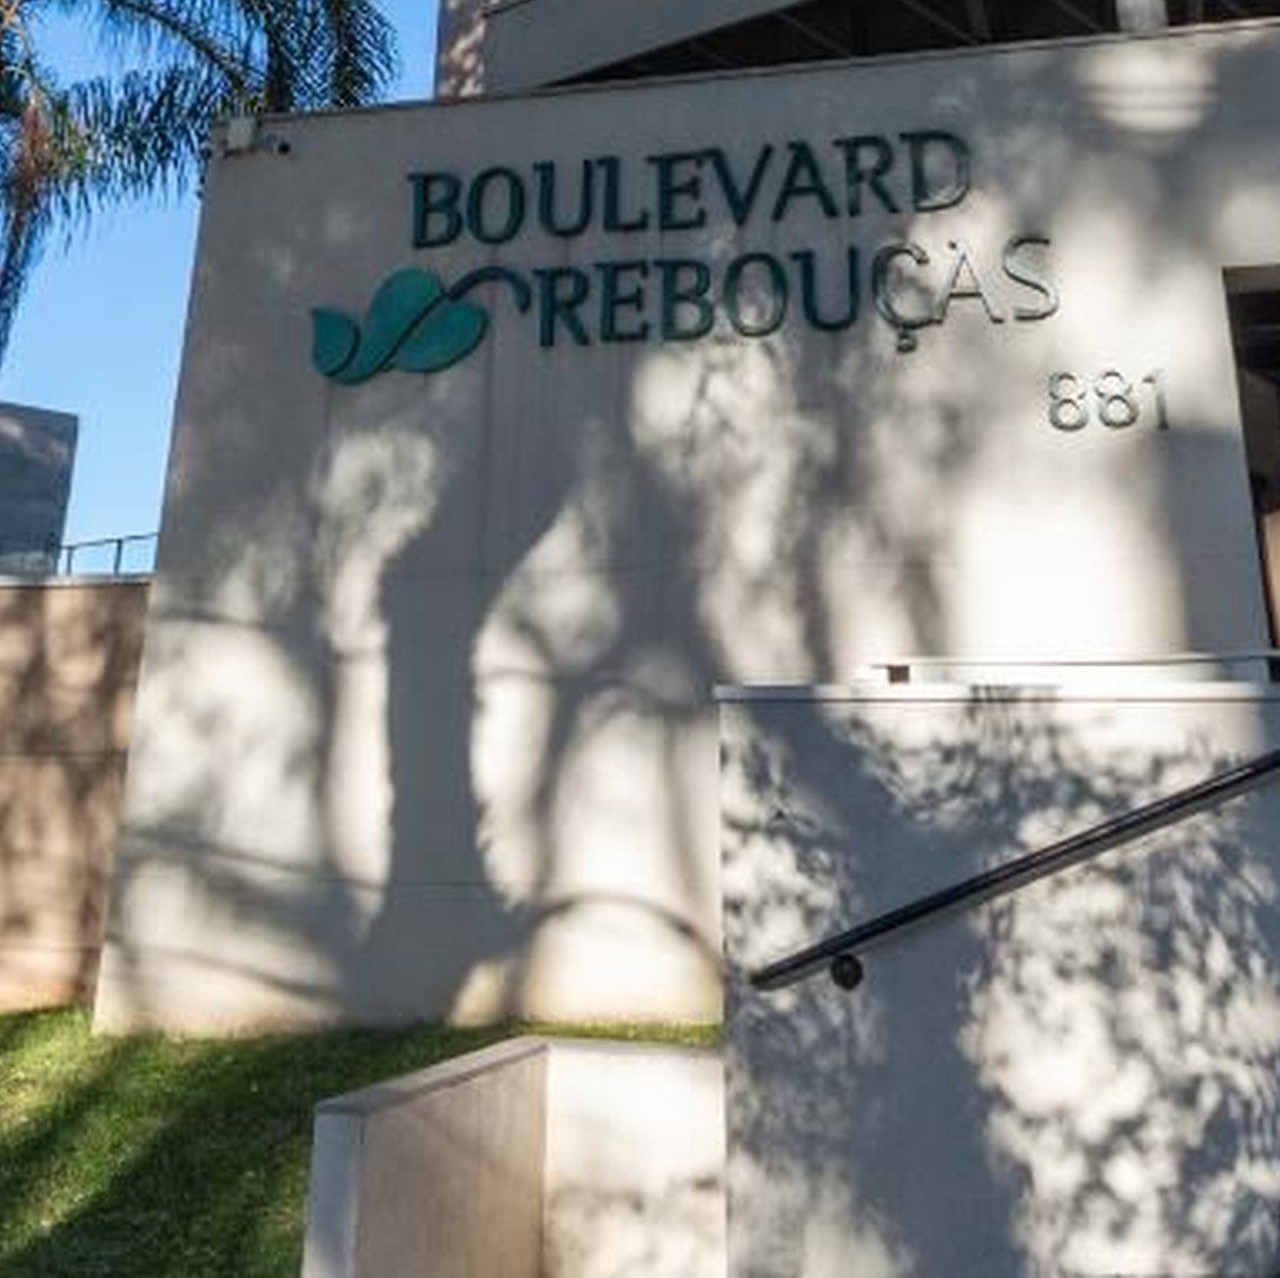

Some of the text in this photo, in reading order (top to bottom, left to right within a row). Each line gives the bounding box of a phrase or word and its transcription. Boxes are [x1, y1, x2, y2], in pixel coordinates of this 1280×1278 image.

[408, 131, 971, 249] BOULEVARD
[533, 237, 1060, 352] REBOUÇAS
[1047, 369, 1170, 431] 881
